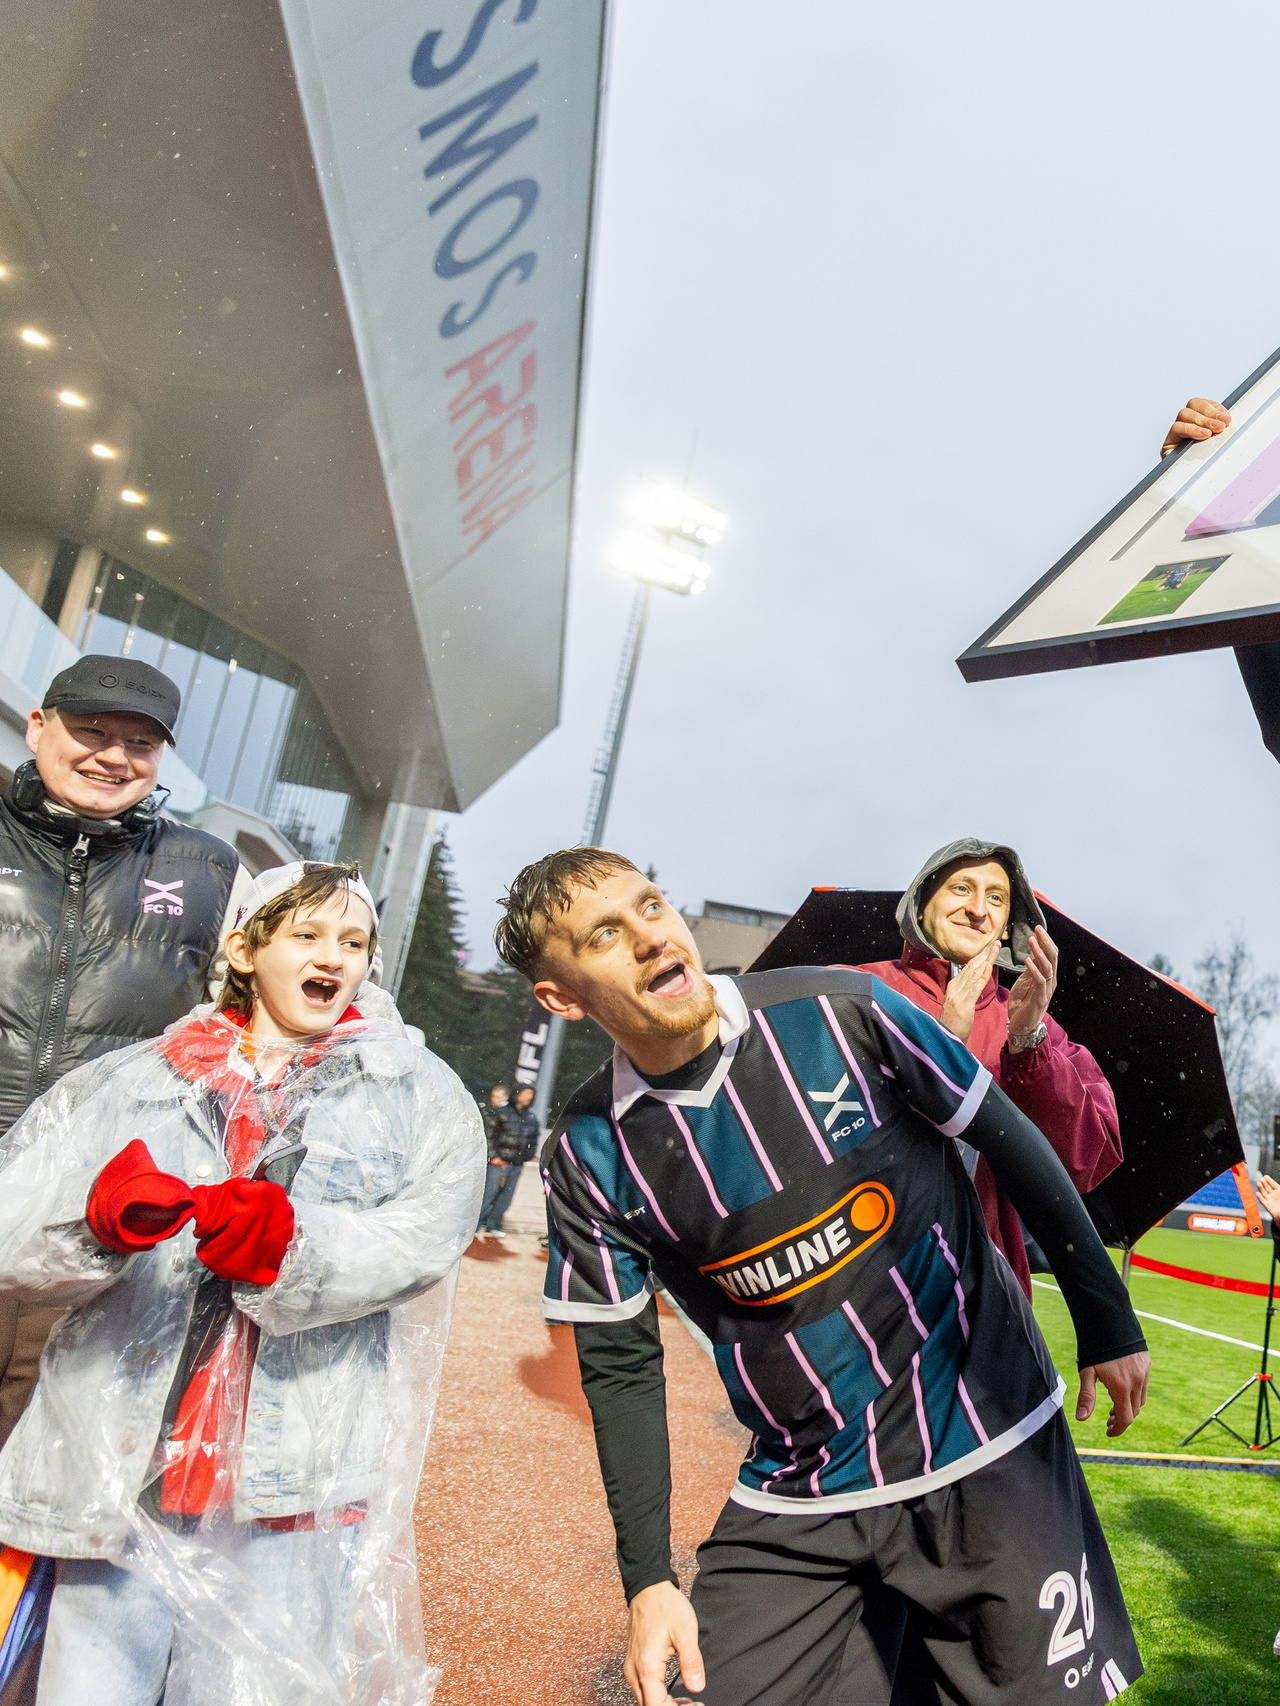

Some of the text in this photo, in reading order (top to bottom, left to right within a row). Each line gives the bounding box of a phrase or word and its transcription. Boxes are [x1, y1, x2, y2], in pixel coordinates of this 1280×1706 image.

[143, 904, 184, 916] FC 10
[831, 1117, 866, 1142] FC 10
[1039, 1552, 1095, 1666] 26
